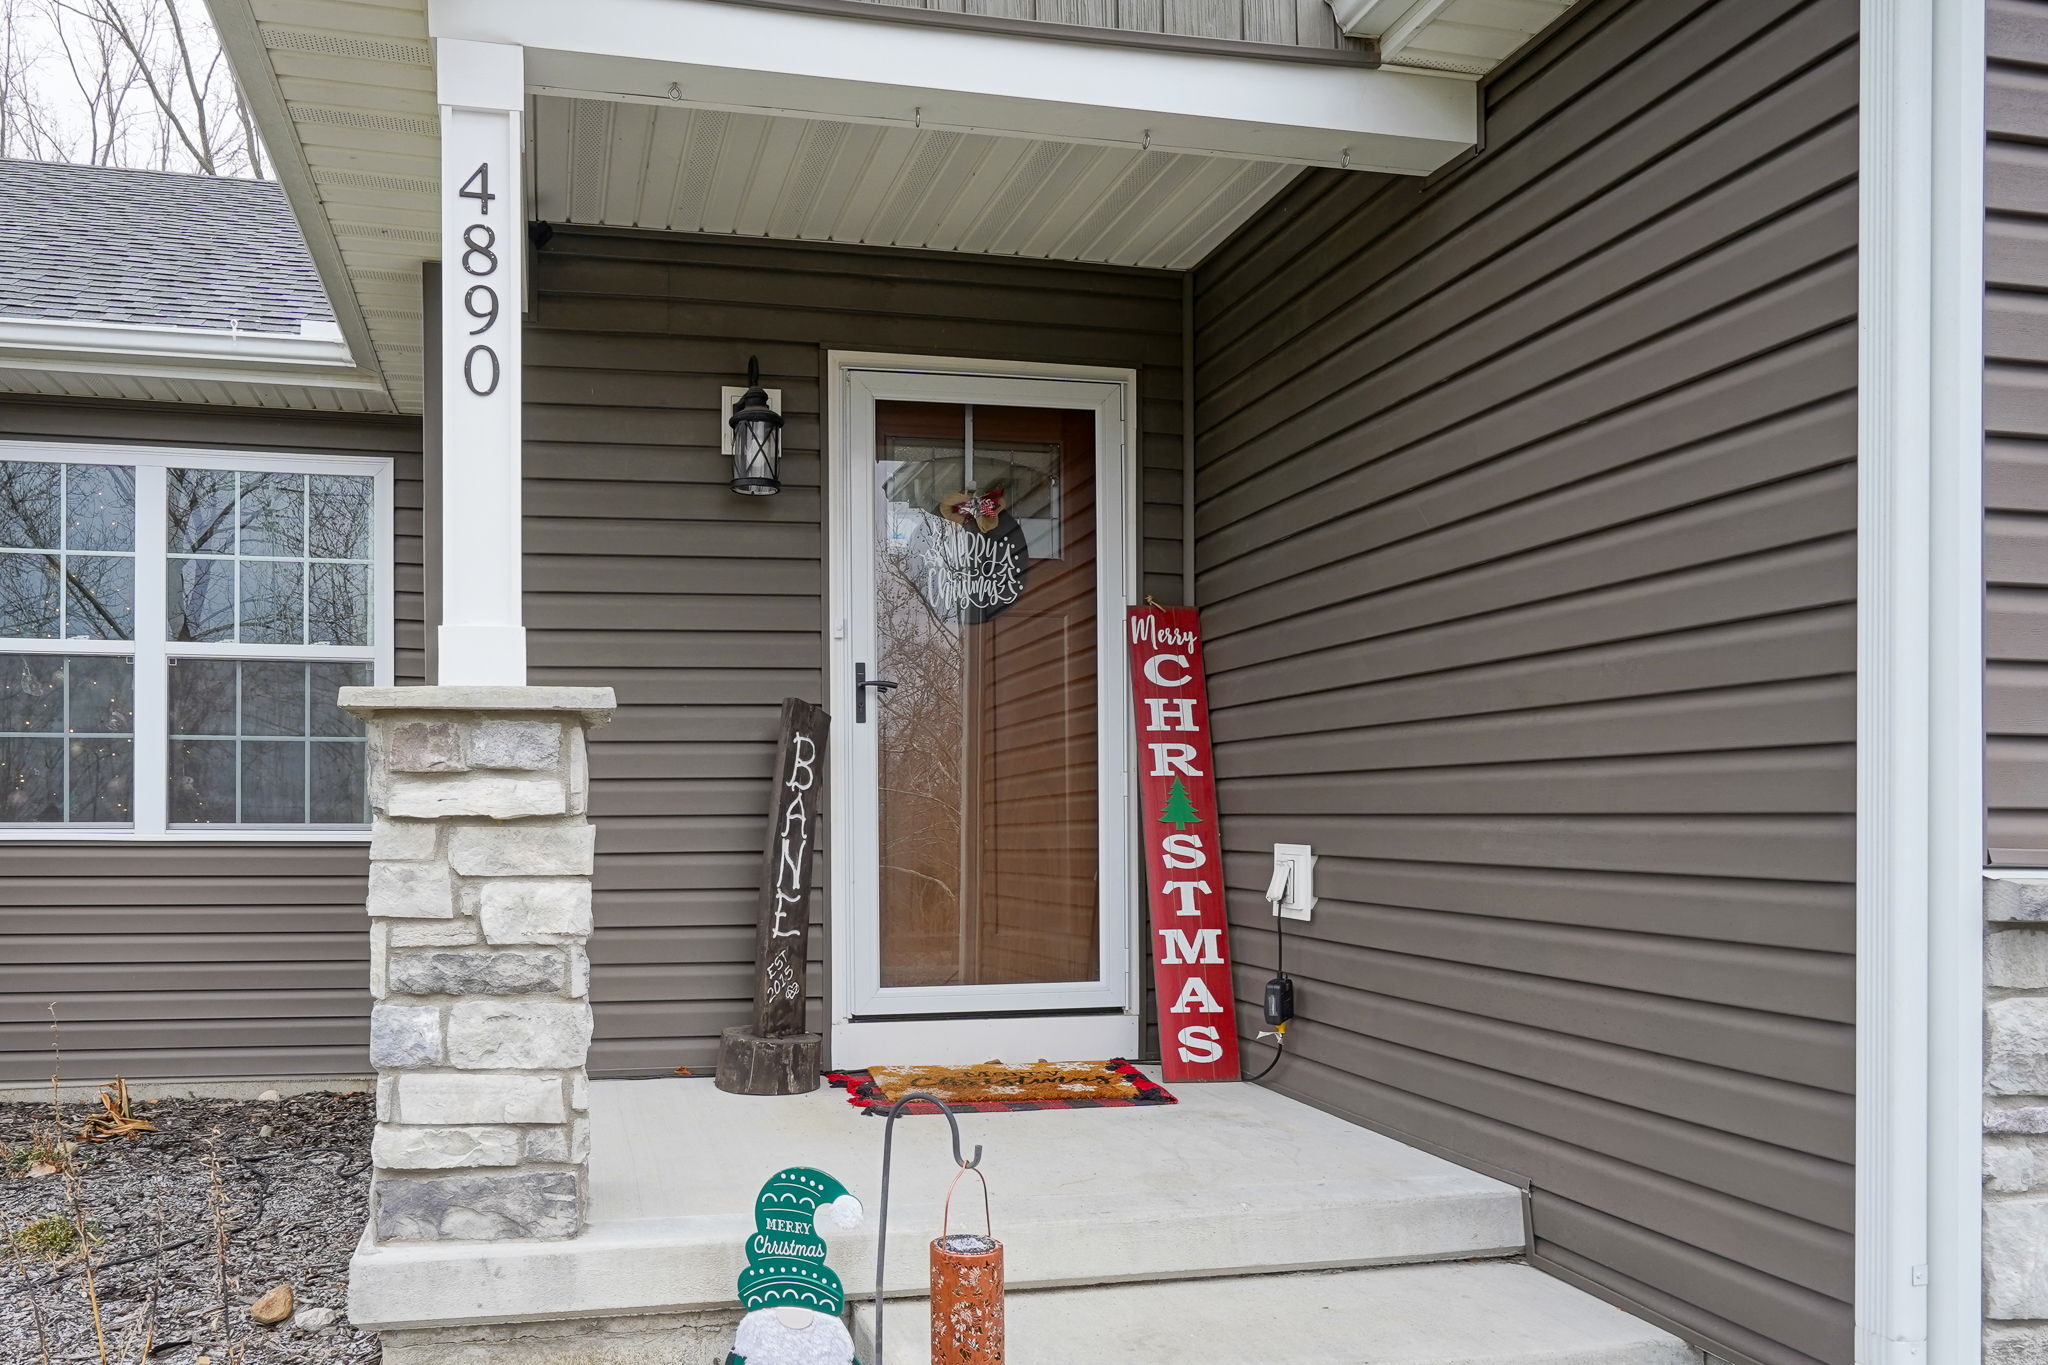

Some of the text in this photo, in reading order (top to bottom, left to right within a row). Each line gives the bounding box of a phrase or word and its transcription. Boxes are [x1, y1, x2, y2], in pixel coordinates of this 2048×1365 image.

[459, 162, 500, 396] 4890
[927, 567, 1012, 610] Christmas
[1131, 614, 1198, 654] Merry
[766, 949, 789, 980] EST
[766, 965, 794, 1004] 2015
[765, 1217, 812, 1235] MERRY
[753, 1235, 825, 1258] Christmas
